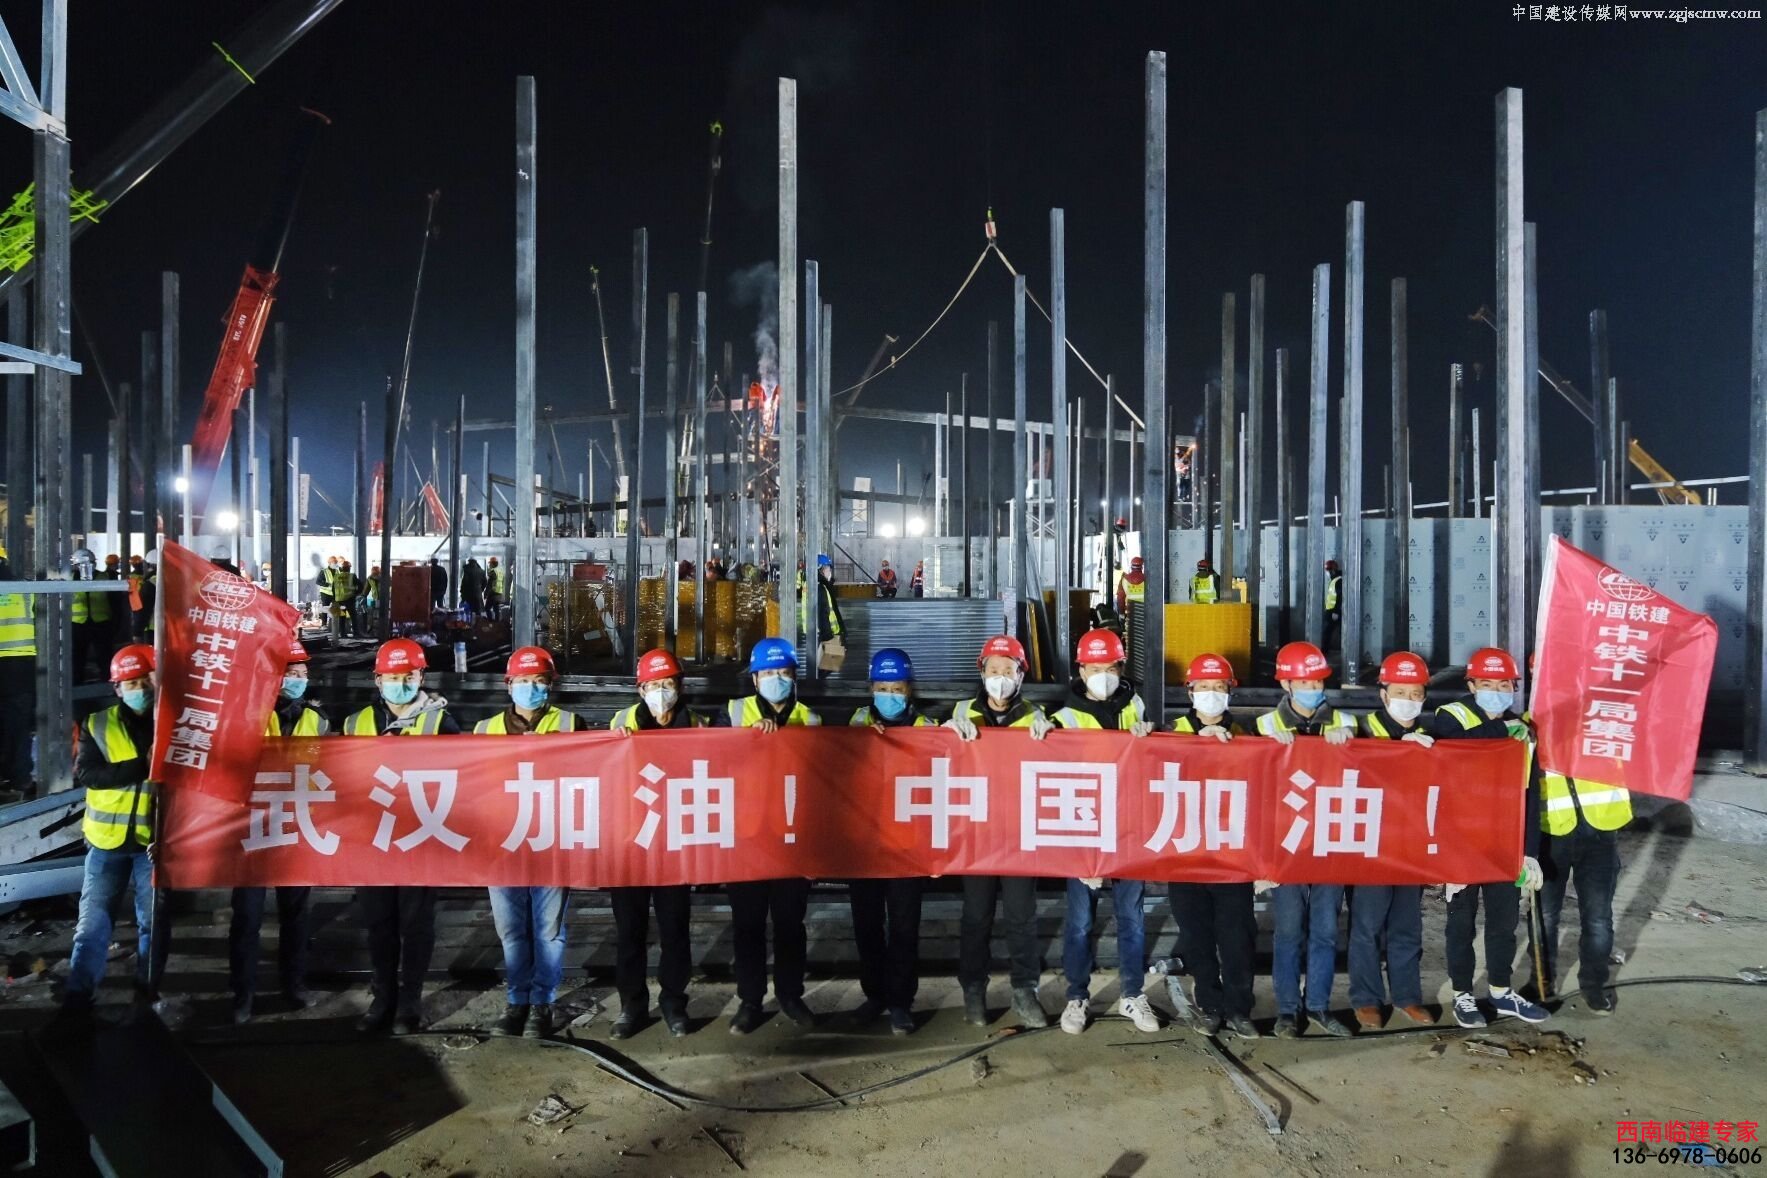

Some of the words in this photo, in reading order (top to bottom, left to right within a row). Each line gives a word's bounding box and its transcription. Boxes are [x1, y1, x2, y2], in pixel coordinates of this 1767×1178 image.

[187, 606, 258, 635] 中国铁建
[1586, 599, 1670, 625] 中国铁建
[164, 632, 237, 770] 中铁十一局集团
[1582, 624, 1649, 761] 中铁十一局集团
